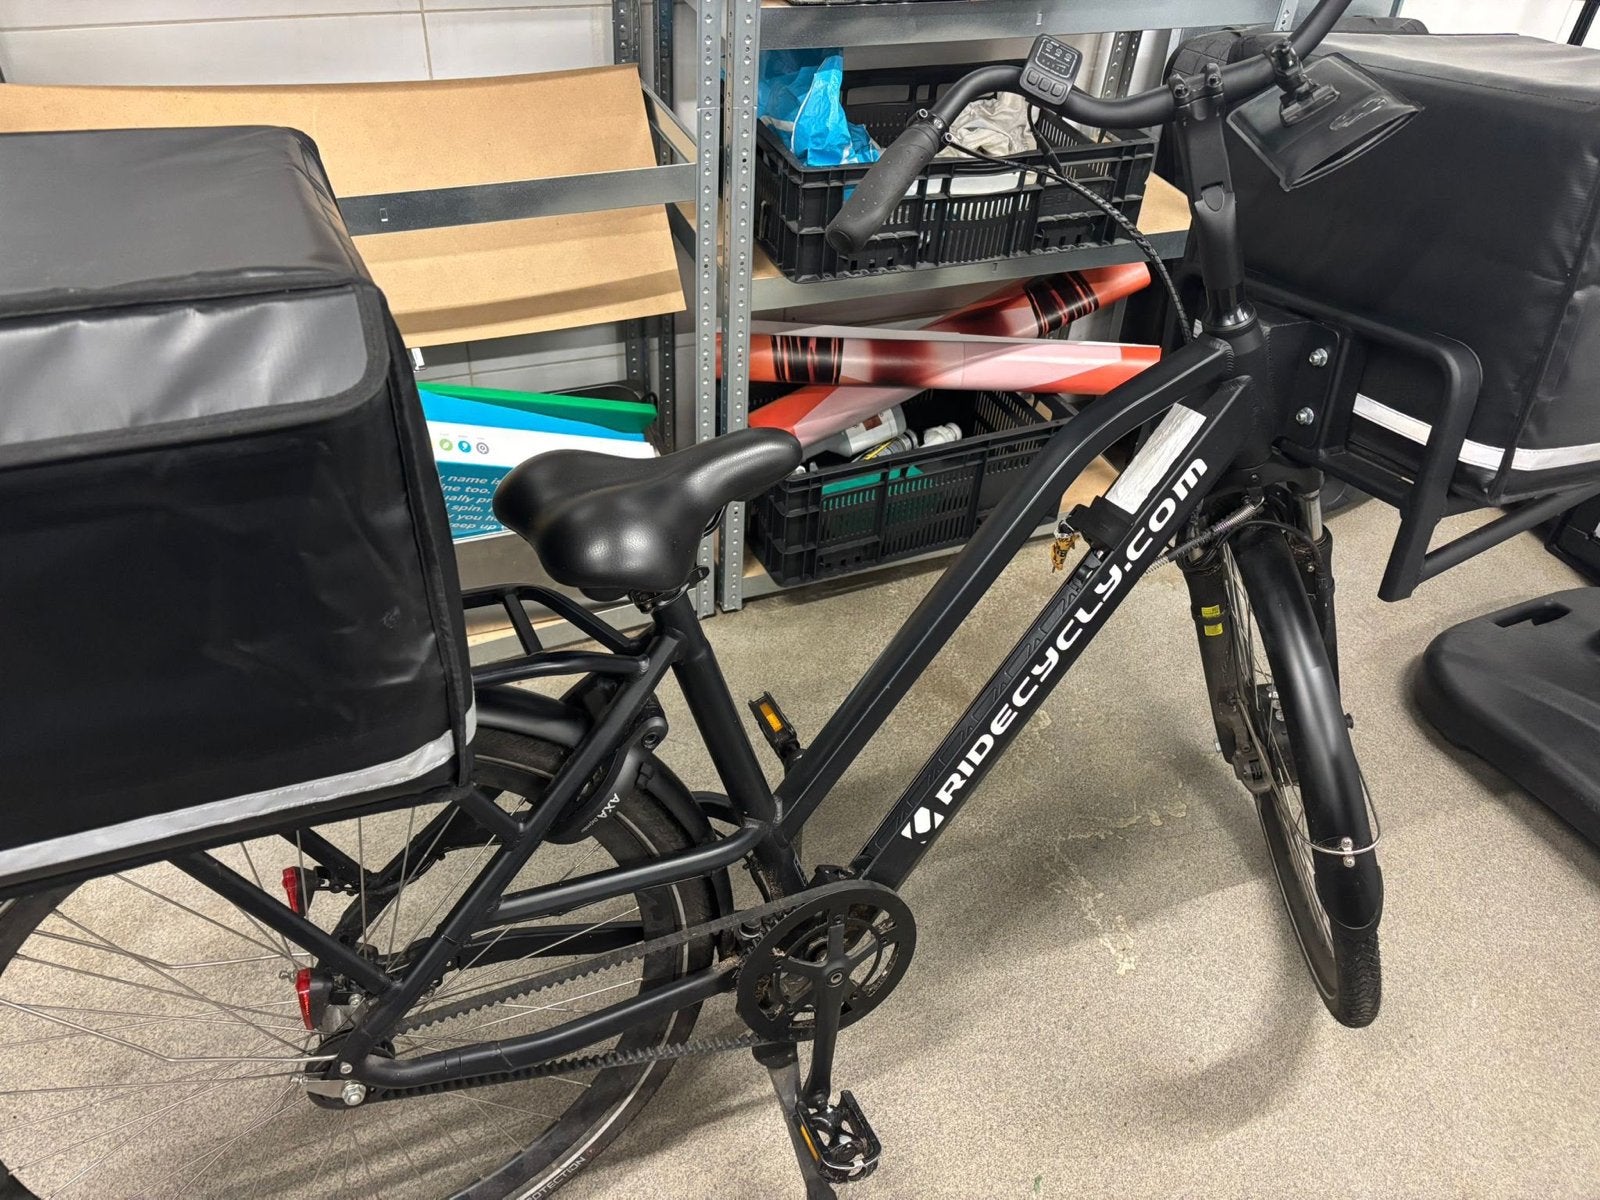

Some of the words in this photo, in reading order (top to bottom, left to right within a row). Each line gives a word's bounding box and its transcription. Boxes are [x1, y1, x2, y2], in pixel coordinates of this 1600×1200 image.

[447, 475, 488, 484] name
[464, 486, 491, 494] too.
[451, 504, 484, 512] spin.
[597, 793, 620, 818] AXA
